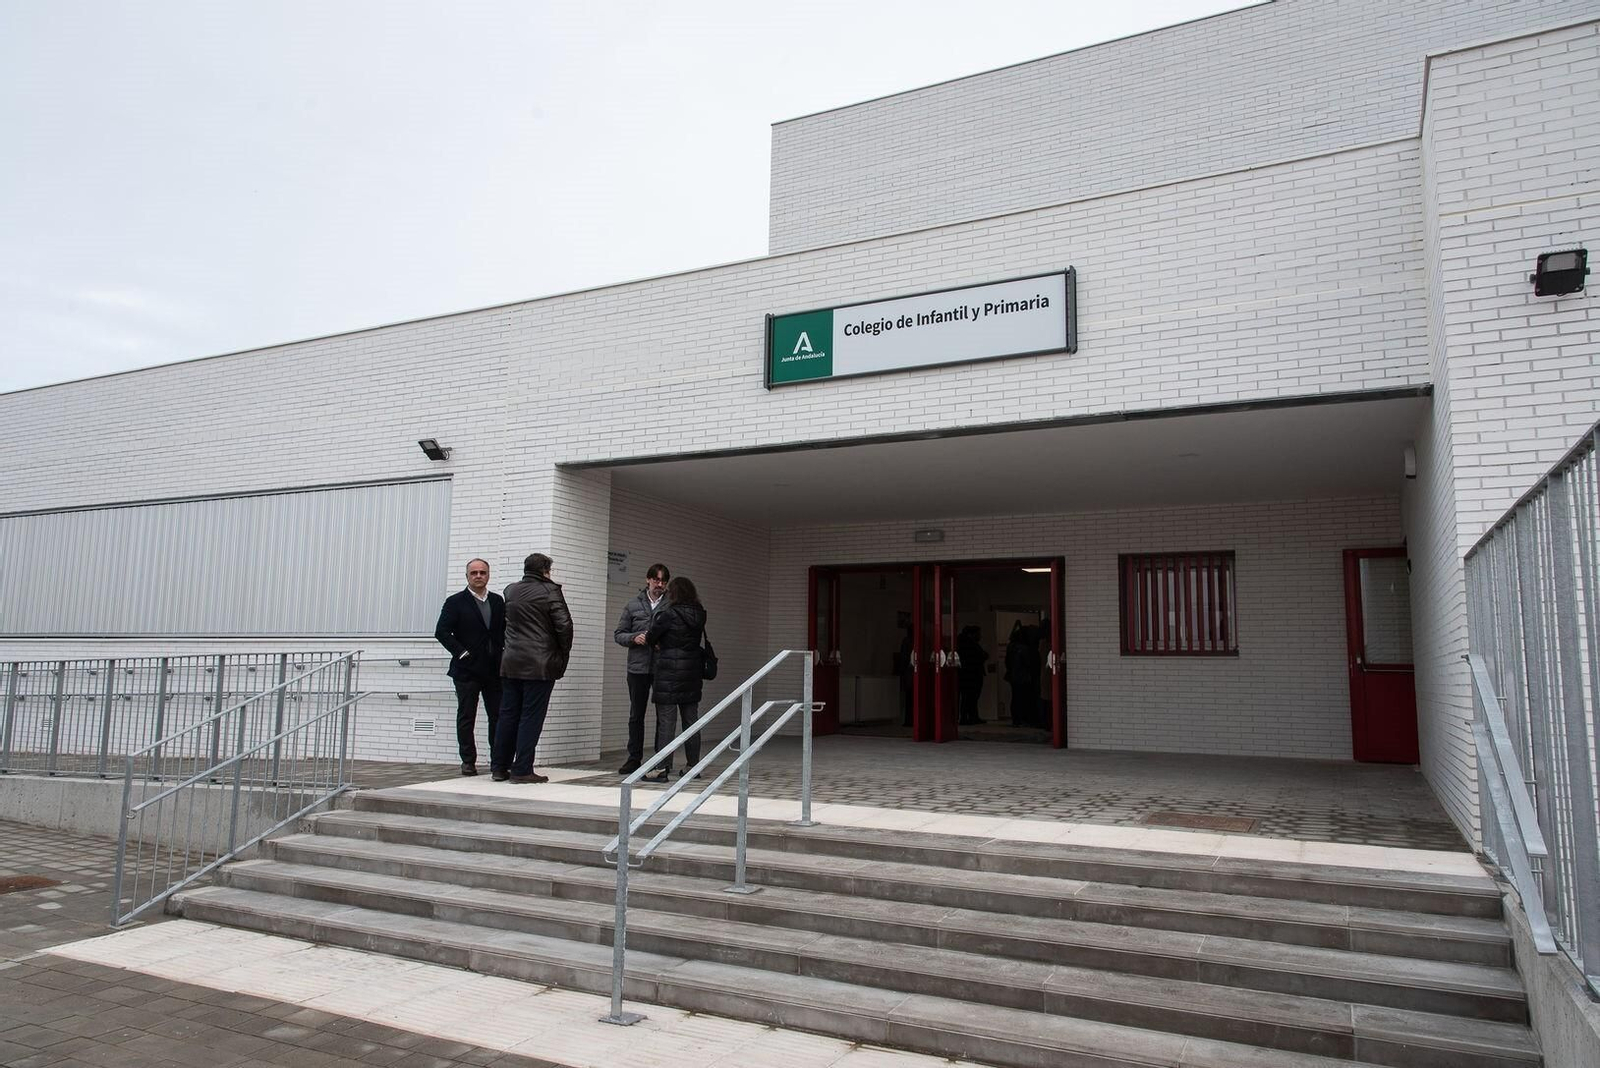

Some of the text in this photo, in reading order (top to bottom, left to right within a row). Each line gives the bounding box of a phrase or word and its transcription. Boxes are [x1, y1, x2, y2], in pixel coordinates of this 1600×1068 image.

[844, 294, 1050, 336] Colegio de Infantil y Primaria
[802, 351, 825, 360] Andalucía
